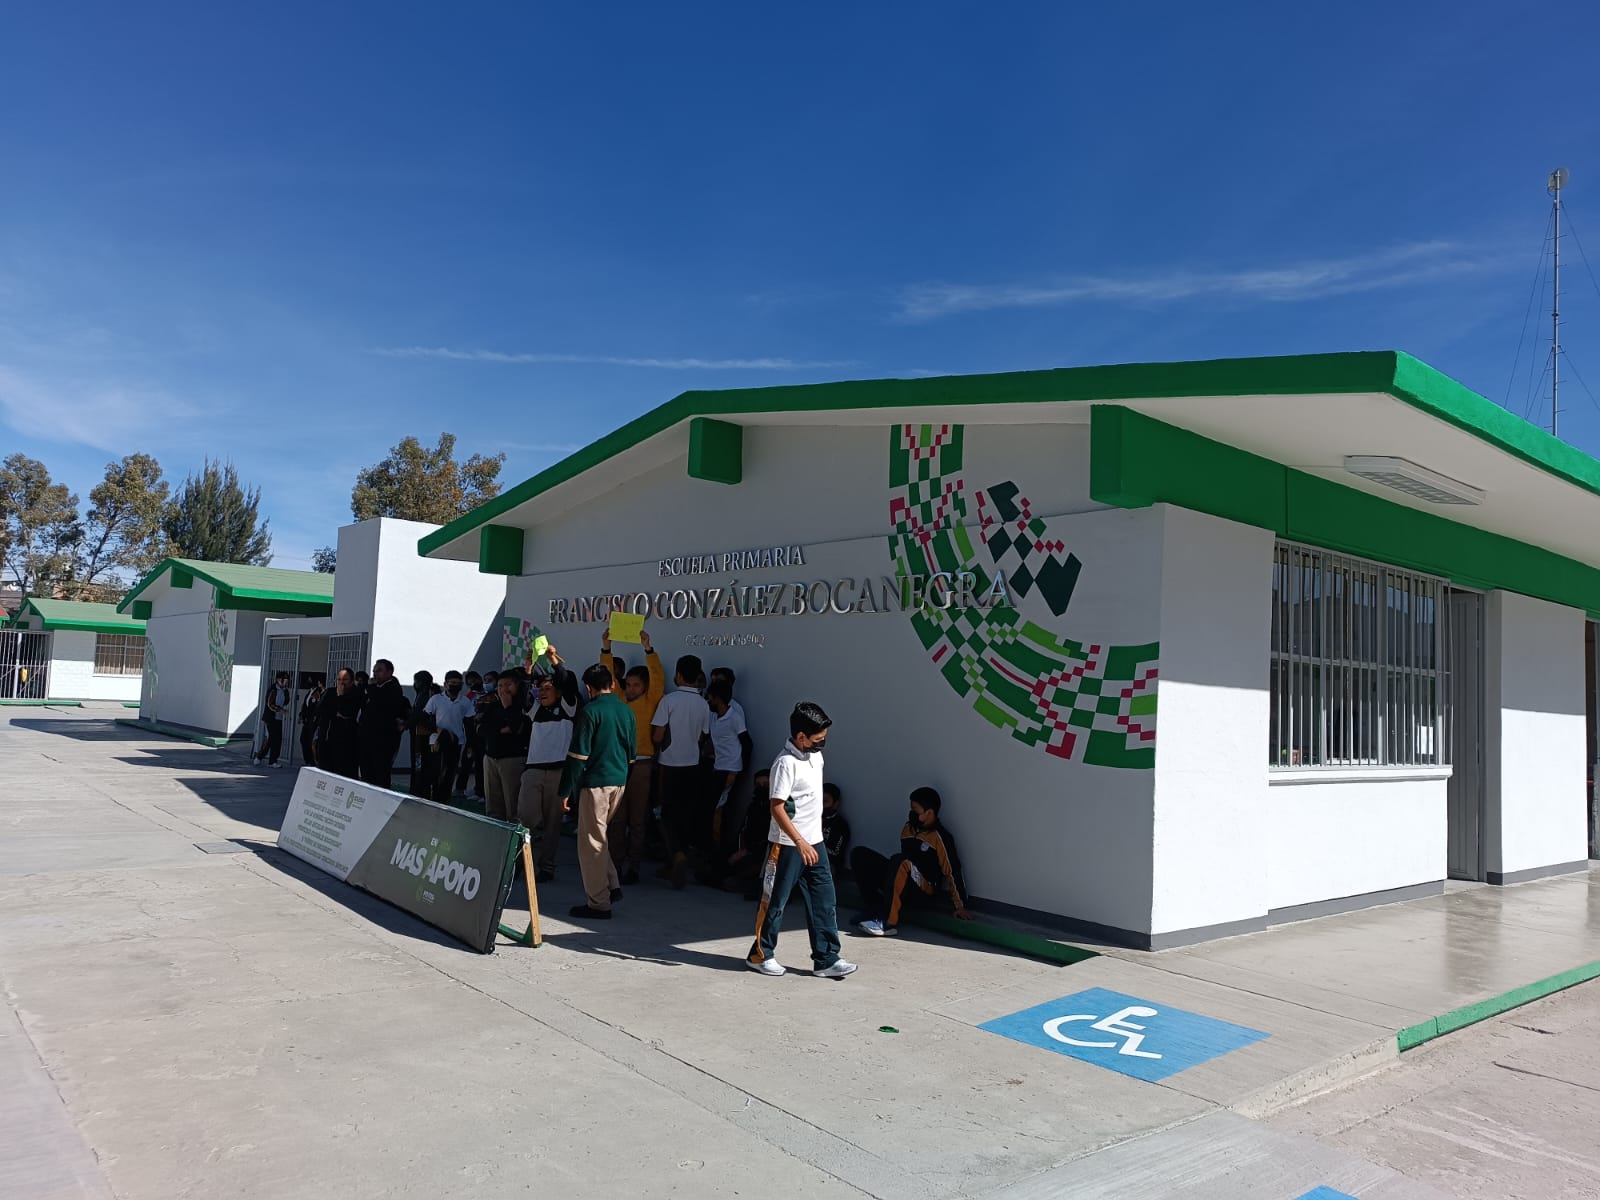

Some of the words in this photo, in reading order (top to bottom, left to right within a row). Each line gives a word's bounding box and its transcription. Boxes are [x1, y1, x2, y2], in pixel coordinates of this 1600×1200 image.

[657, 555, 719, 577] ESCUELA
[722, 544, 806, 572] PRIMARIA
[547, 592, 652, 624] FRANCISCO
[654, 579, 787, 620] GONZÁLEZ
[788, 568, 1017, 616] BOCANEGRA
[421, 853, 481, 900] APOYO
